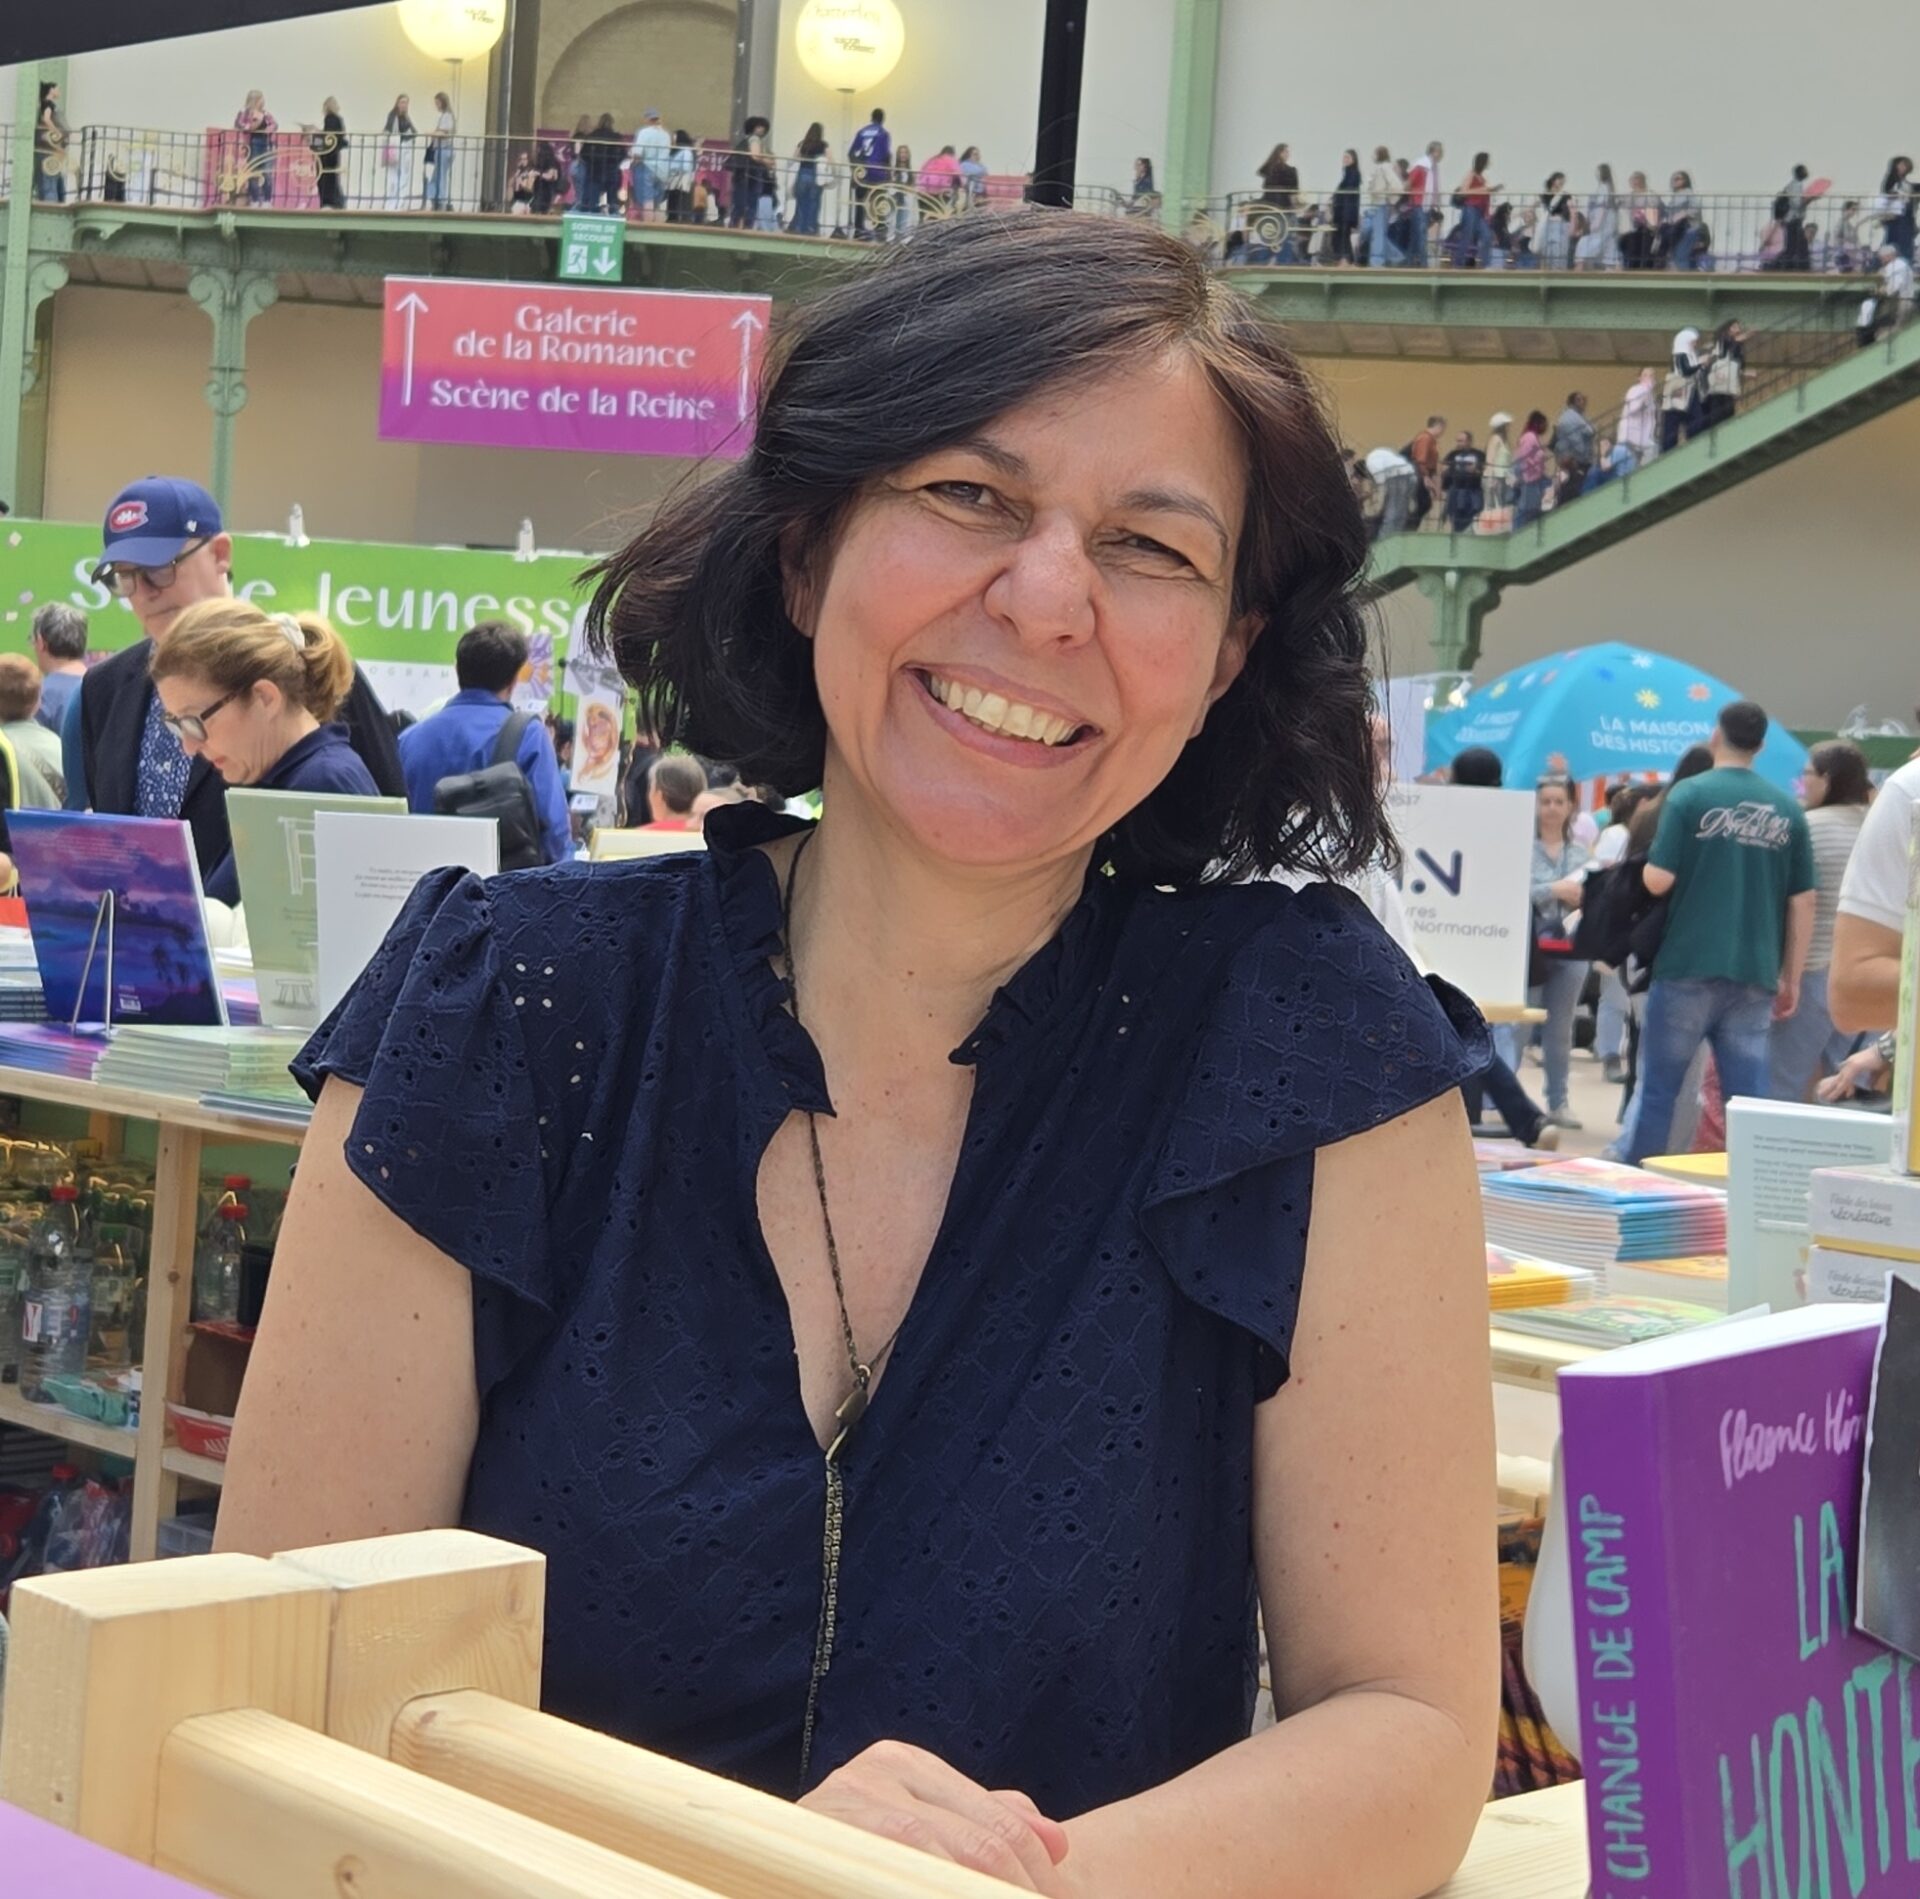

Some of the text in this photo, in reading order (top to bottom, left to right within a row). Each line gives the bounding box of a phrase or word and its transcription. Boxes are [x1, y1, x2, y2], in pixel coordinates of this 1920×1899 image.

[572, 222, 617, 233] SORTIE DE
[573, 233, 614, 243] SECOURS
[516, 305, 638, 337] Galerie
[454, 330, 696, 369] de la Romance
[431, 379, 716, 421] Scène de la Reine
[318, 570, 590, 640] Jeuness
[369, 666, 450, 679] OGRAM
[1591, 731, 1691, 754] DES HISTO
[1600, 716, 1710, 736] LA MAISON
[1414, 920, 1509, 938] Normandie
[1719, 1409, 1819, 1490] Florence
[1579, 1493, 1632, 1617] CAMP
[1794, 1501, 1852, 1662] LA
[1589, 1626, 1636, 1680] DE
[1593, 1700, 1651, 1881] CHANGE
